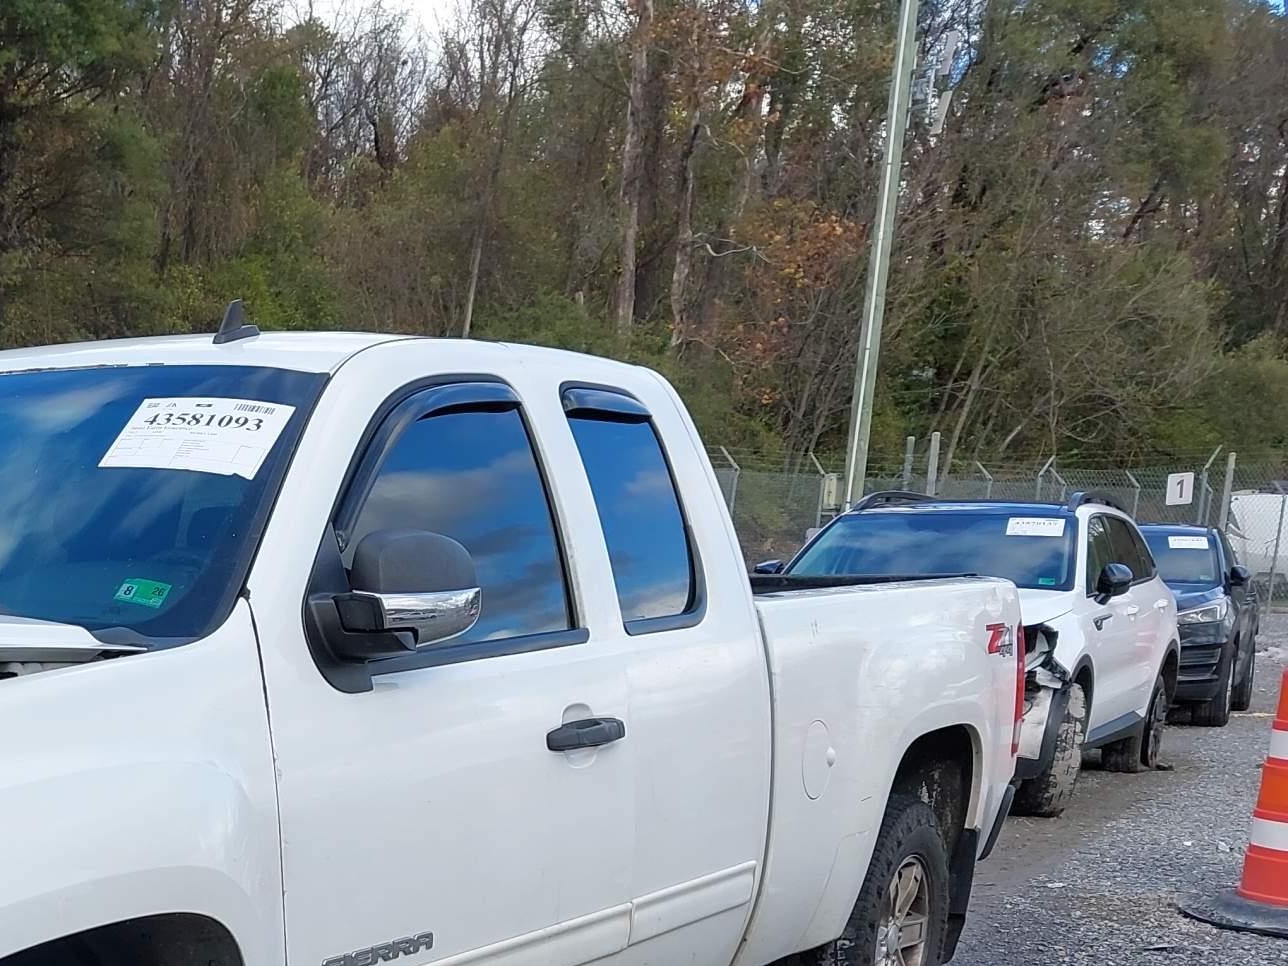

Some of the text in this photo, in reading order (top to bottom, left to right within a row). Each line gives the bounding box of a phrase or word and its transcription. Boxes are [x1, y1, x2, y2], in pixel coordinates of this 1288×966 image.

[144, 412, 264, 432] 43581093
[1176, 479, 1185, 498] 1
[123, 585, 134, 596] 8
